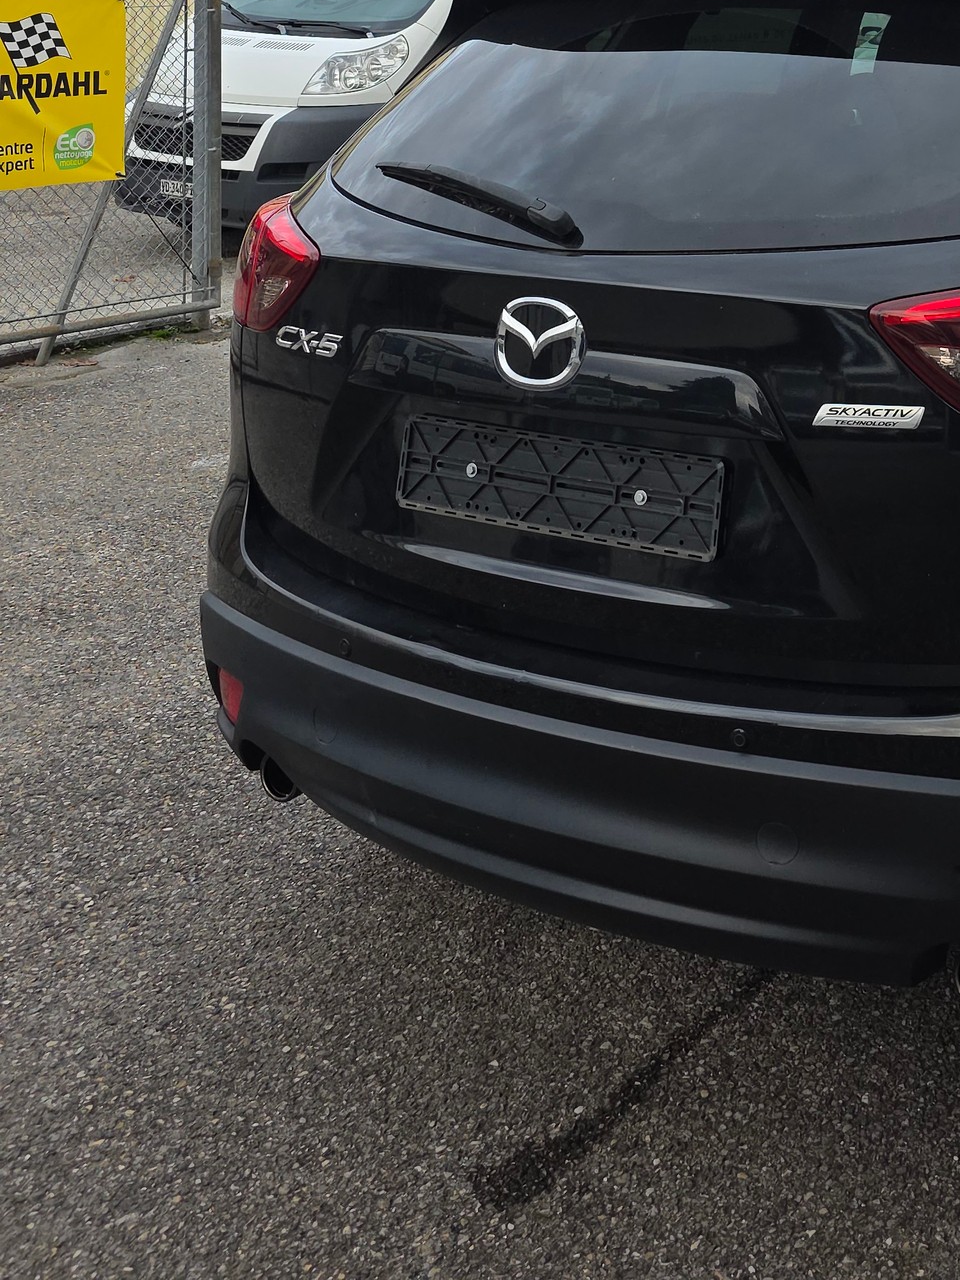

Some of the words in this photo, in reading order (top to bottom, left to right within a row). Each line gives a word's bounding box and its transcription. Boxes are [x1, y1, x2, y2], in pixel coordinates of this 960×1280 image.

[55, 150, 93, 160] nettoyage
[275, 325, 344, 358] CX-5
[826, 406, 913, 418] SKYACTIV
[835, 419, 900, 427] TECHNOLOGY
